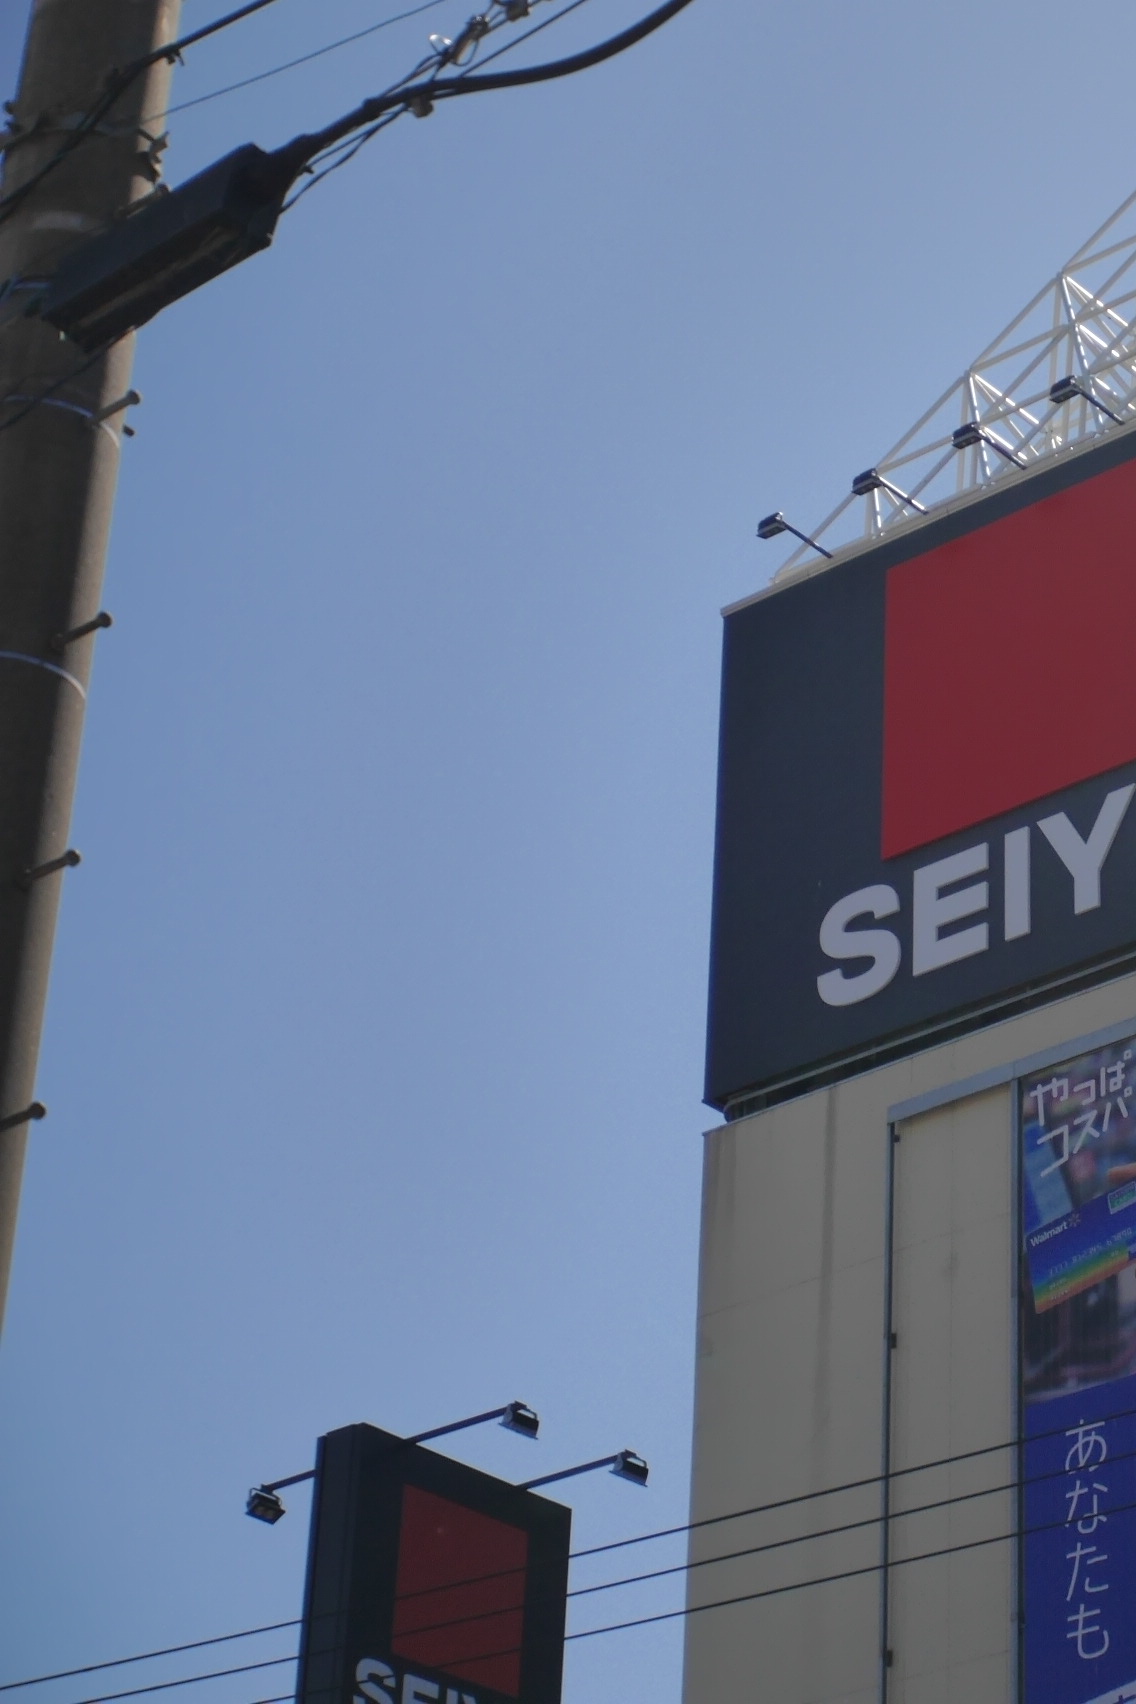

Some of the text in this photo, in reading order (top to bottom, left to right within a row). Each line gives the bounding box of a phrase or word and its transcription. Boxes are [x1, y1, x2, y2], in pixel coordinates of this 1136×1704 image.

[1029, 1049, 1133, 1127] やっぱ
[1036, 1086, 1133, 1178] コスパ
[1030, 1221, 1068, 1247] Walmart
[1064, 1418, 1110, 1660] あなたも
